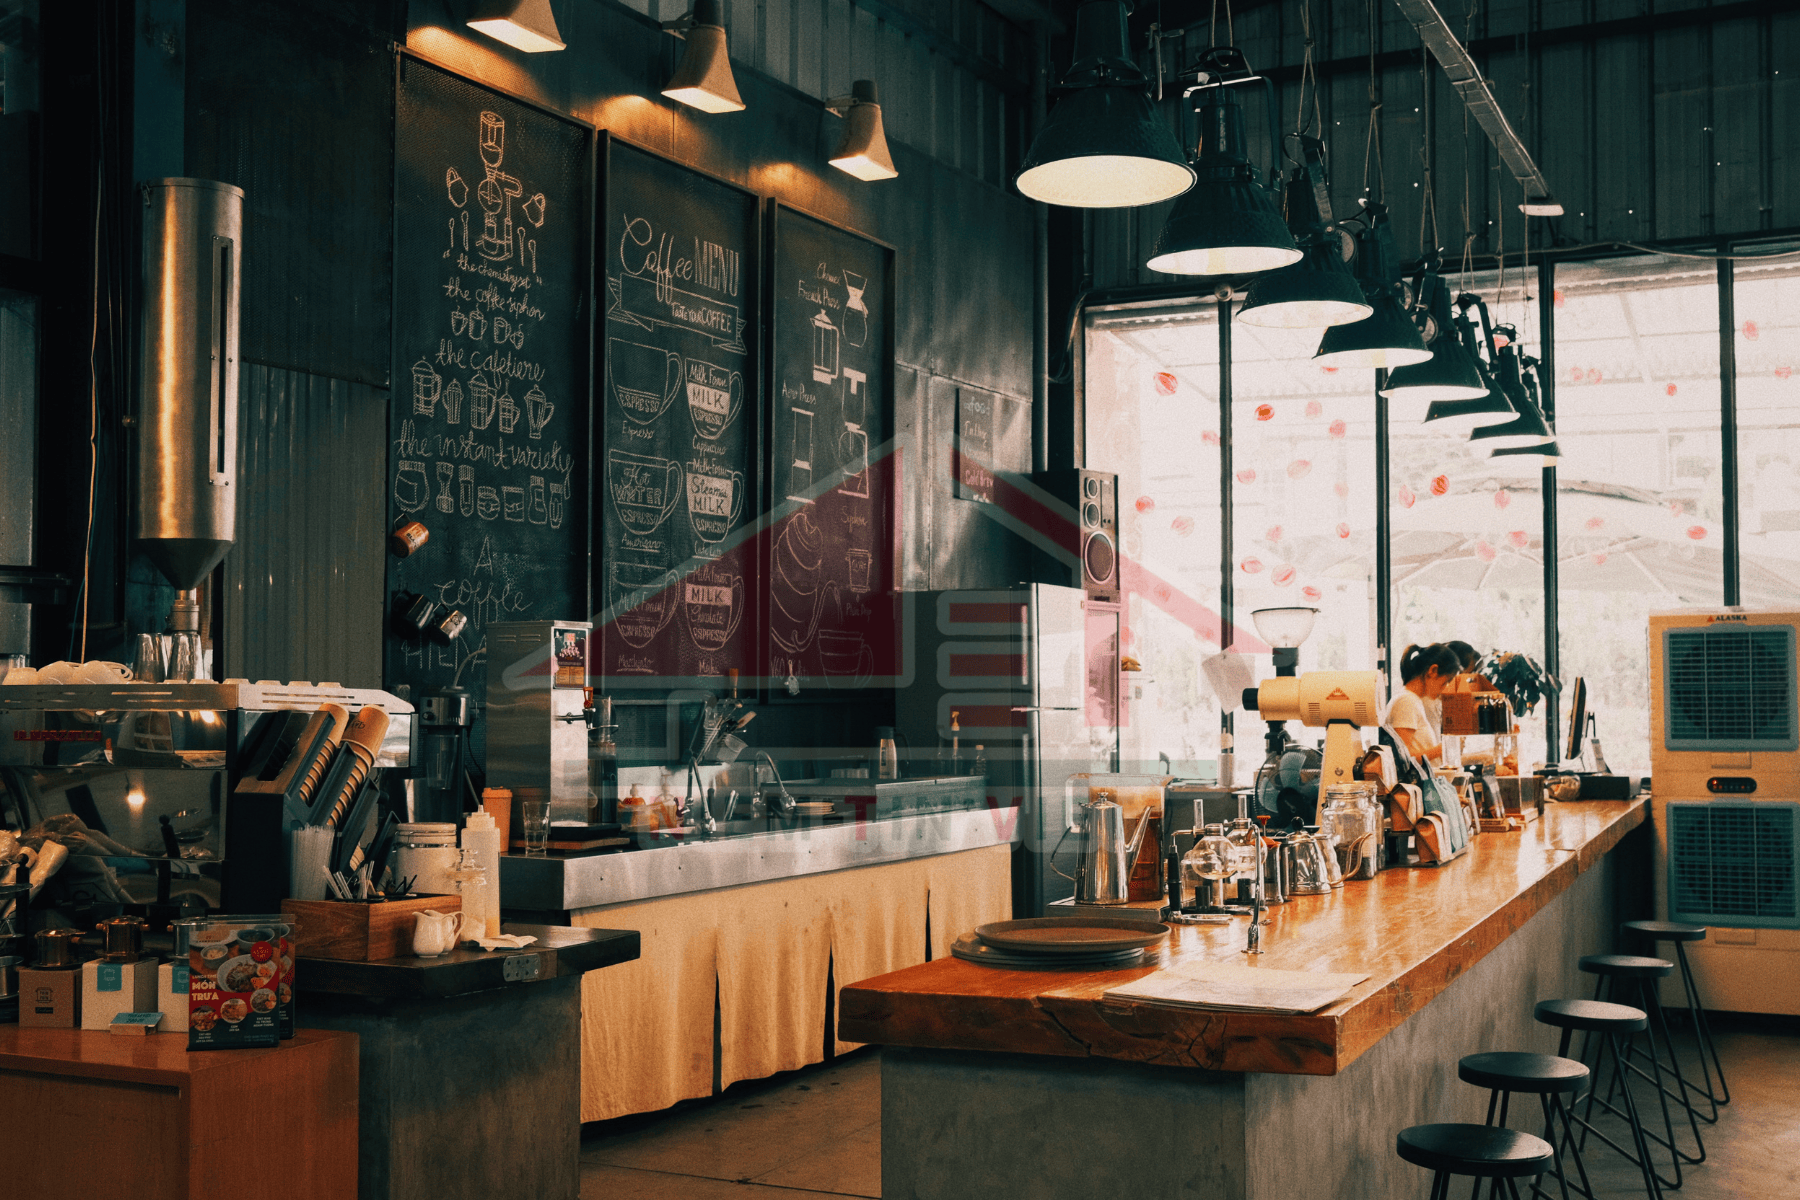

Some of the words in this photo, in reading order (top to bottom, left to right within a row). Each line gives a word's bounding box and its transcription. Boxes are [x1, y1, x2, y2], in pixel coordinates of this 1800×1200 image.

[620, 213, 694, 305] Coffee
[694, 236, 740, 297] MENU
[442, 276, 472, 301] the
[475, 281, 505, 312] coffee
[435, 338, 468, 369] the
[692, 386, 725, 411] MILK
[393, 418, 434, 458] the
[507, 440, 575, 500] variety
[693, 495, 725, 514] MILK
[473, 534, 494, 577] A
[691, 586, 724, 603] MILK
[191, 979, 216, 991] MÓN
